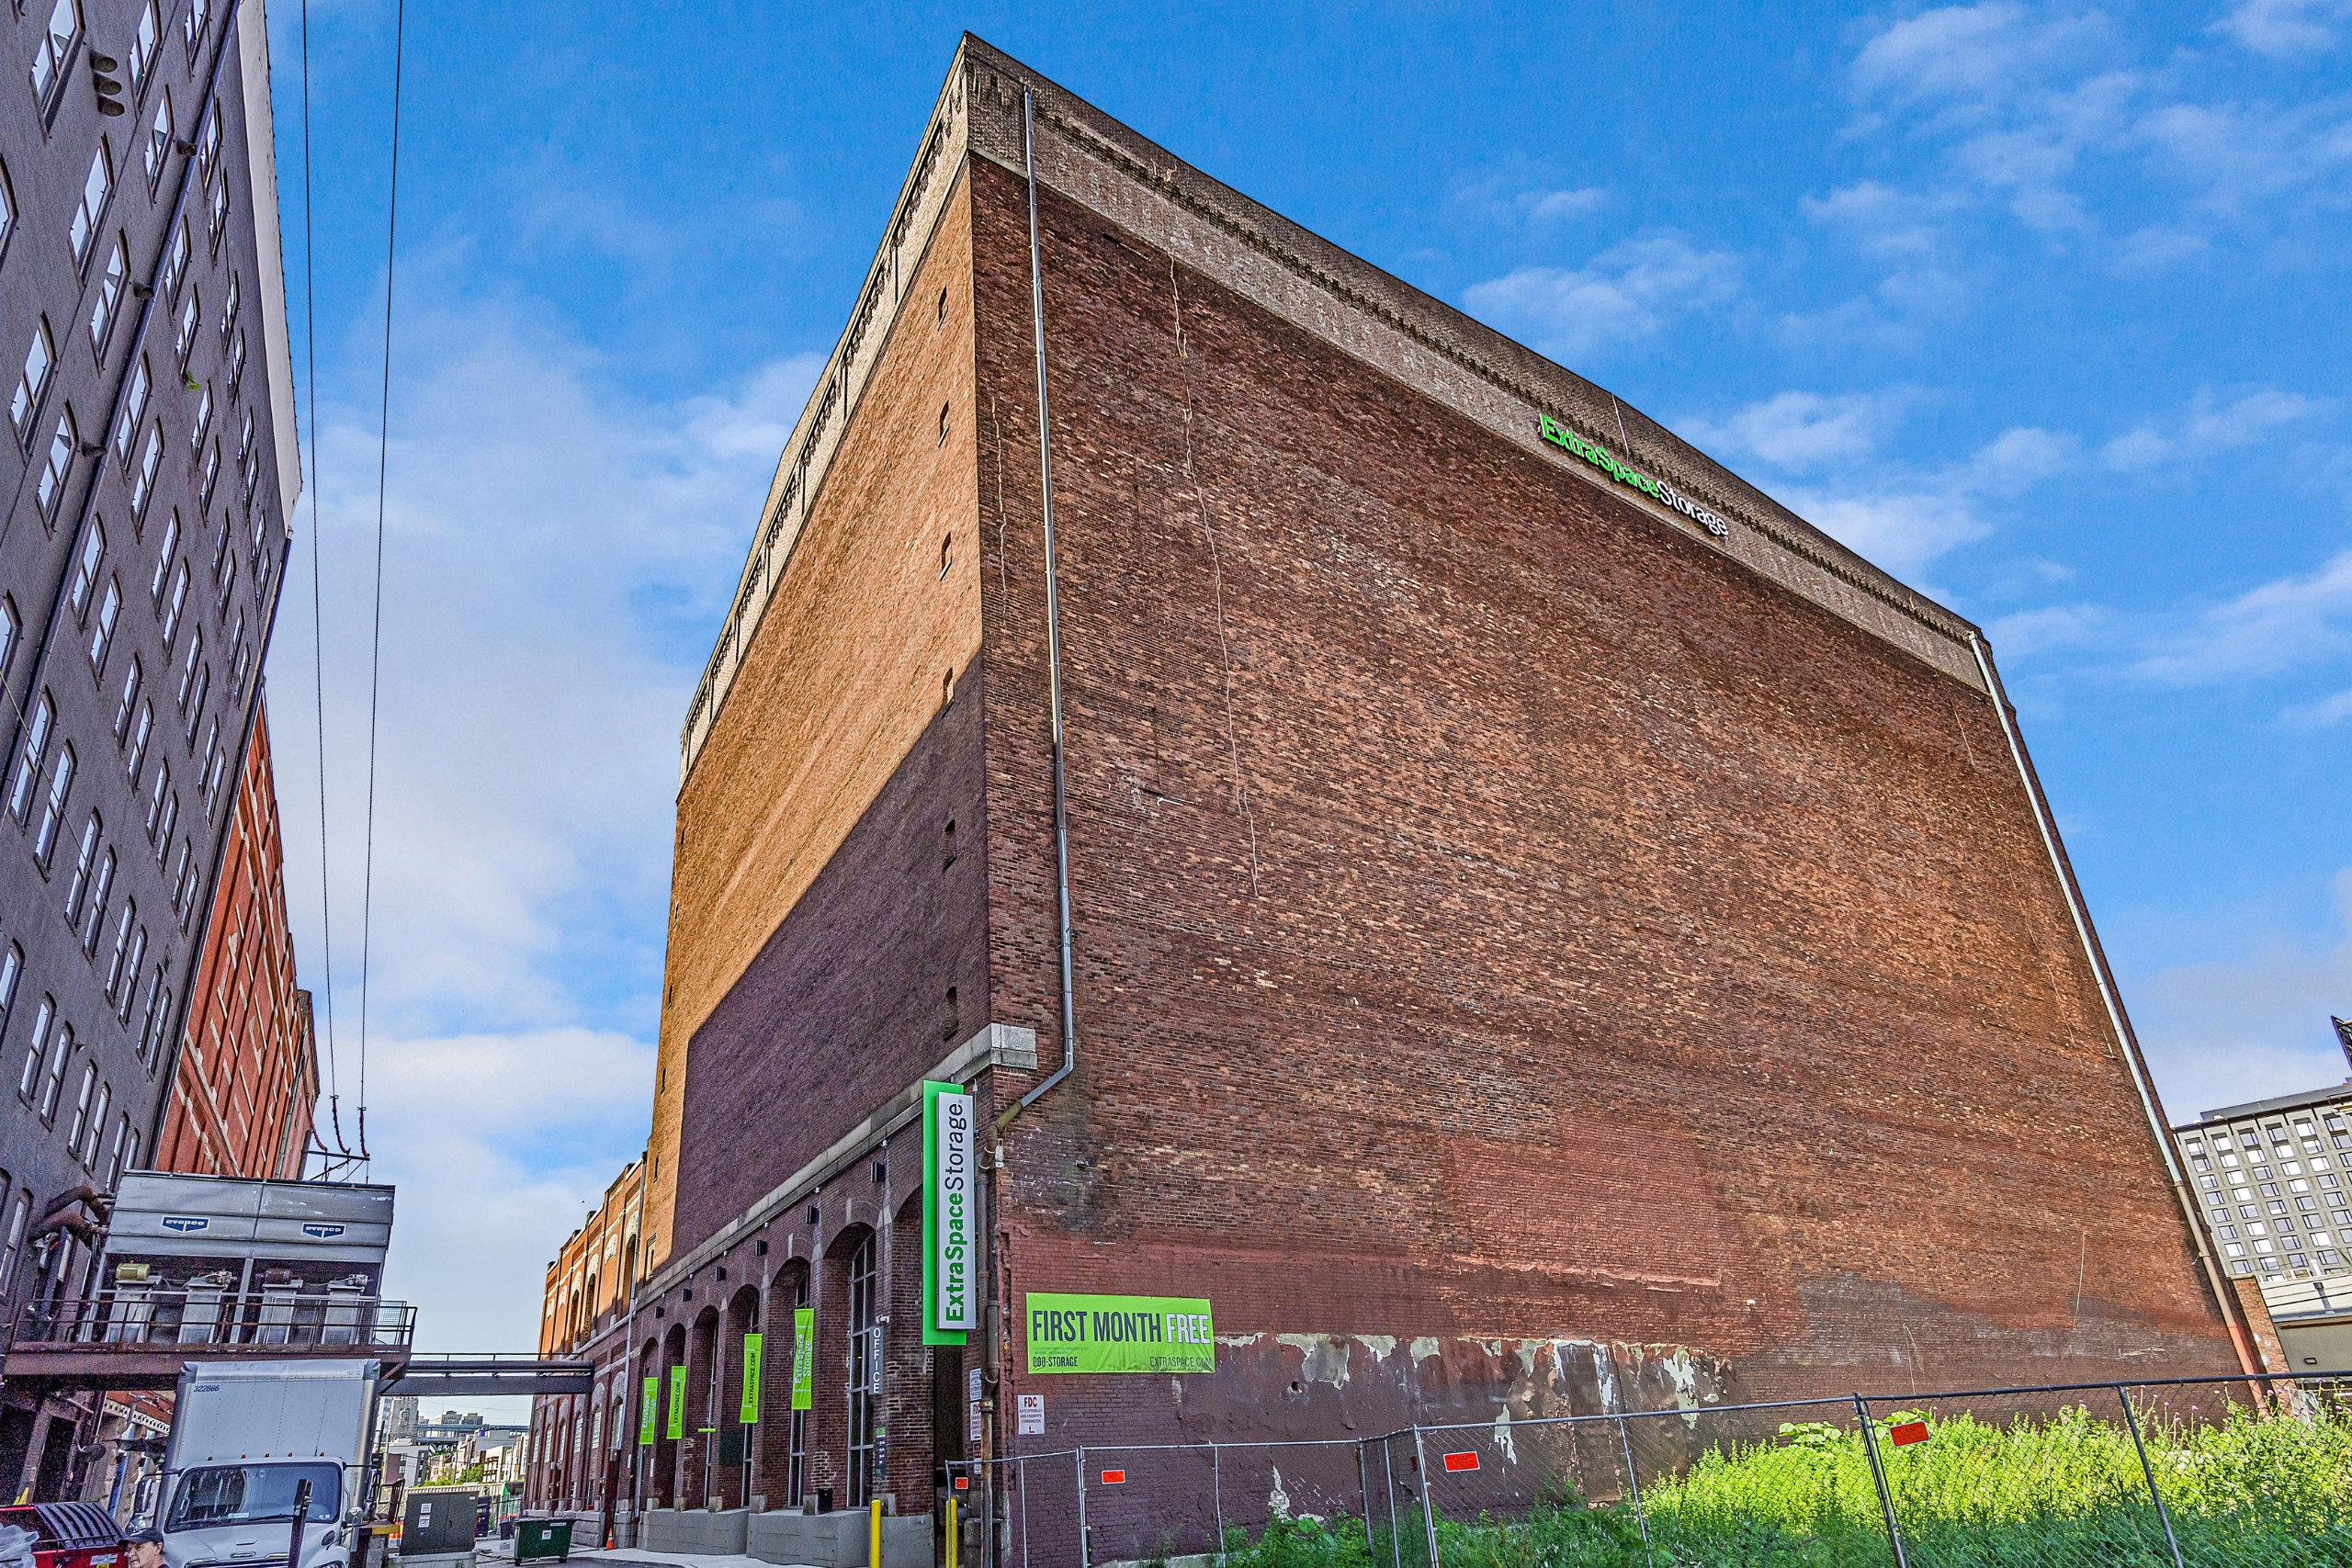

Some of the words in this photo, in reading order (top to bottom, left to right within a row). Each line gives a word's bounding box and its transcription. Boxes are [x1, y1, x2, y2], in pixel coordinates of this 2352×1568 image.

[165, 1219, 205, 1230] evapco
[305, 1225, 342, 1236] evapco
[1032, 1310, 1088, 1342] FIRST
[1093, 1311, 1162, 1343] MONTH
[1166, 1313, 1211, 1344] FREE
[873, 1327, 881, 1393] OFFICE
[1149, 1356, 1212, 1368] EXTRASPACE.COM
[193, 1384, 220, 1393] 322866
[1023, 1396, 1037, 1407] FDC
